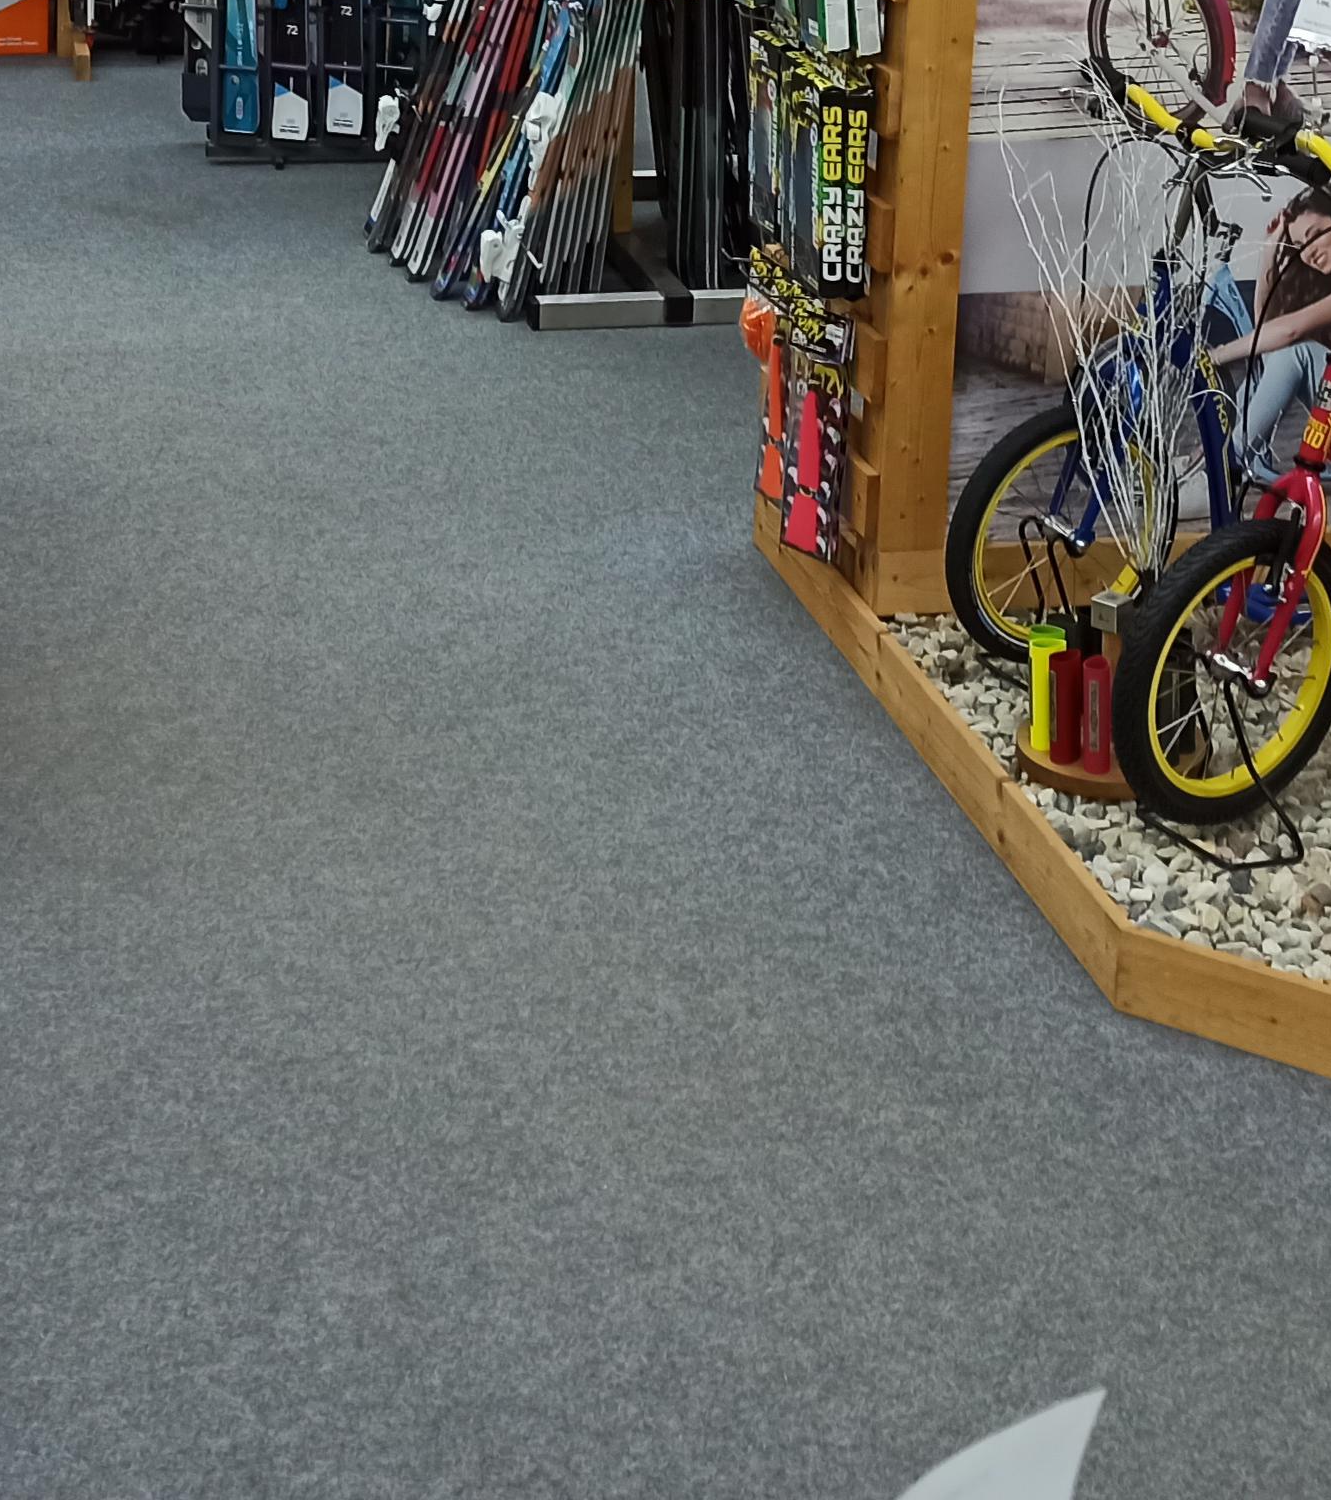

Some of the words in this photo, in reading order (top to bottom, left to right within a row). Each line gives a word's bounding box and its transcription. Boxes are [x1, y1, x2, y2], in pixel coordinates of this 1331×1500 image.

[286, 24, 299, 36] 72
[340, 5, 353, 17] 72
[823, 105, 843, 181] EARS
[847, 110, 868, 184] EARS
[821, 186, 843, 282] CRAZY
[846, 189, 865, 283] CRAZY
